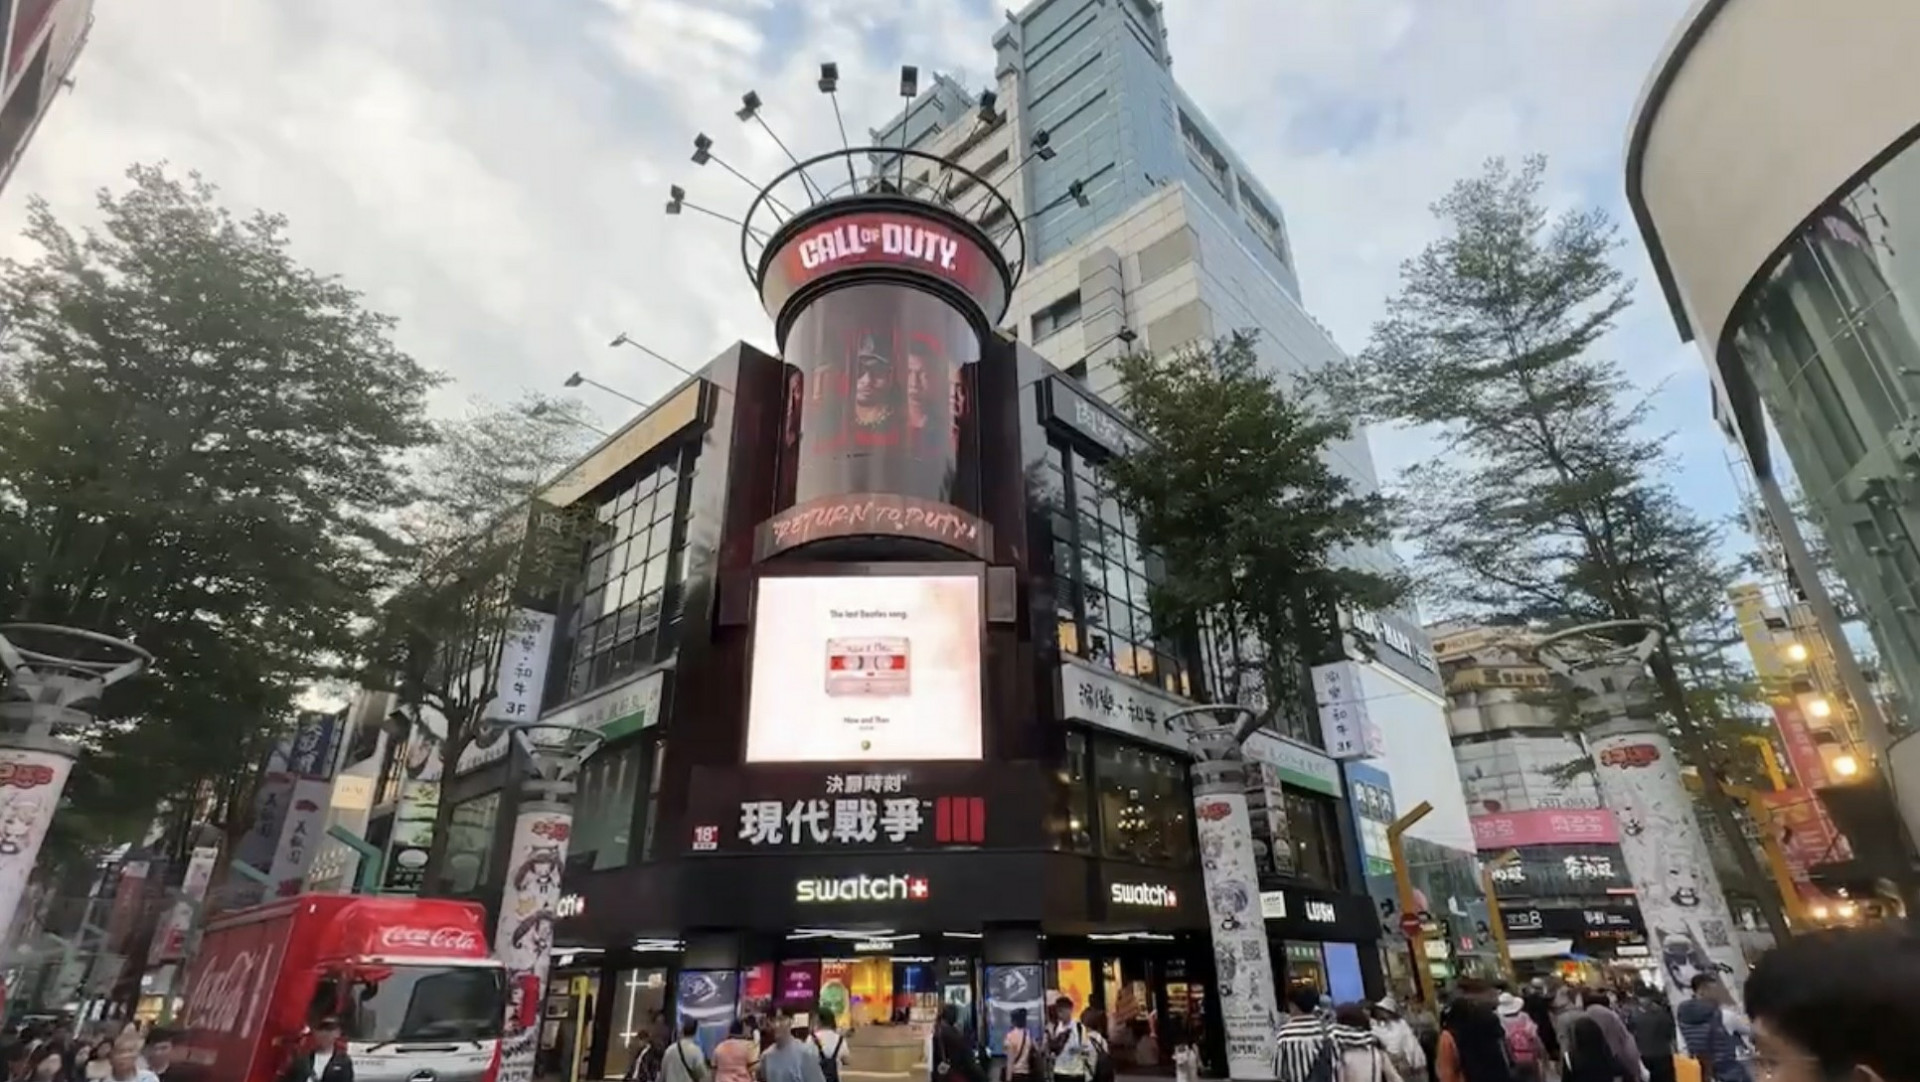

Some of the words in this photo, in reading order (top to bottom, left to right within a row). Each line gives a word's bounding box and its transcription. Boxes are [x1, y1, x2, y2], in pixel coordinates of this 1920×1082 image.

[799, 224, 866, 269] CALL
[861, 228, 880, 243] OF
[876, 506, 900, 523] TO
[830, 609, 843, 618] The
[845, 609, 858, 618] last
[860, 609, 887, 618] Beatles
[505, 701, 527, 716] 3F
[844, 716, 859, 724] Now
[861, 716, 873, 724] and
[875, 716, 890, 724] Then
[739, 797, 923, 845] 現代戰爭
[796, 873, 906, 901] swatch
[1111, 883, 1167, 906] swatch
[1305, 901, 1336, 923] LUSH
